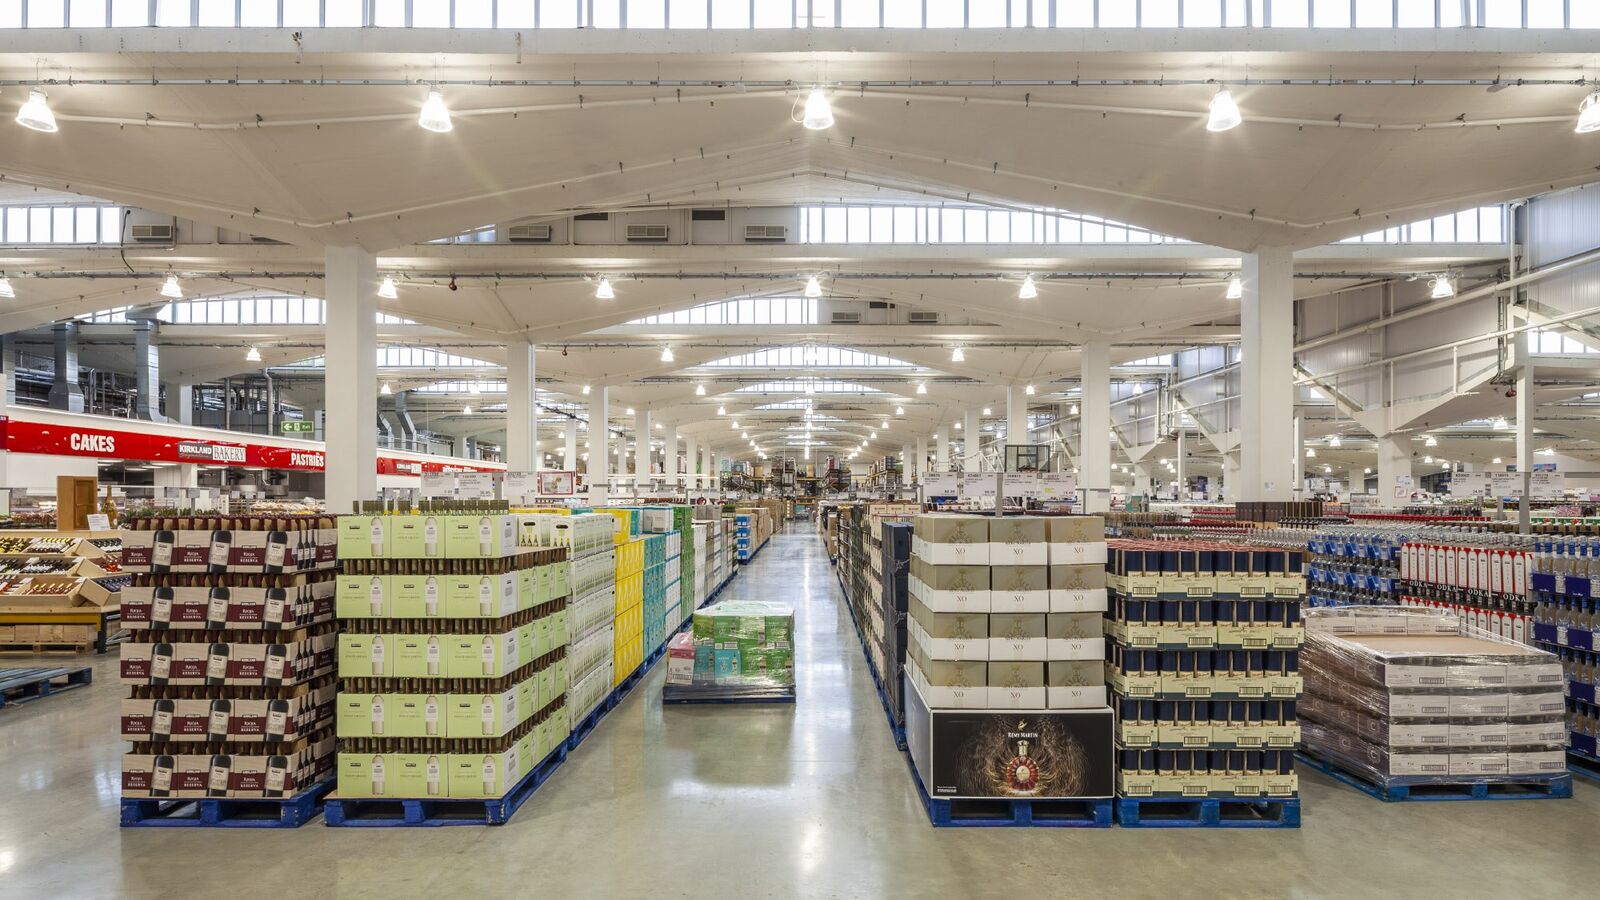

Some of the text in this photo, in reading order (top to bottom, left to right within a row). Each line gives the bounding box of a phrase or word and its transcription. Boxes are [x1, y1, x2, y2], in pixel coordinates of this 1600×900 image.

[70, 433, 115, 453] CAKES
[179, 444, 246, 461] KIRKLAND BAKERY
[290, 452, 325, 468] PASTRIES
